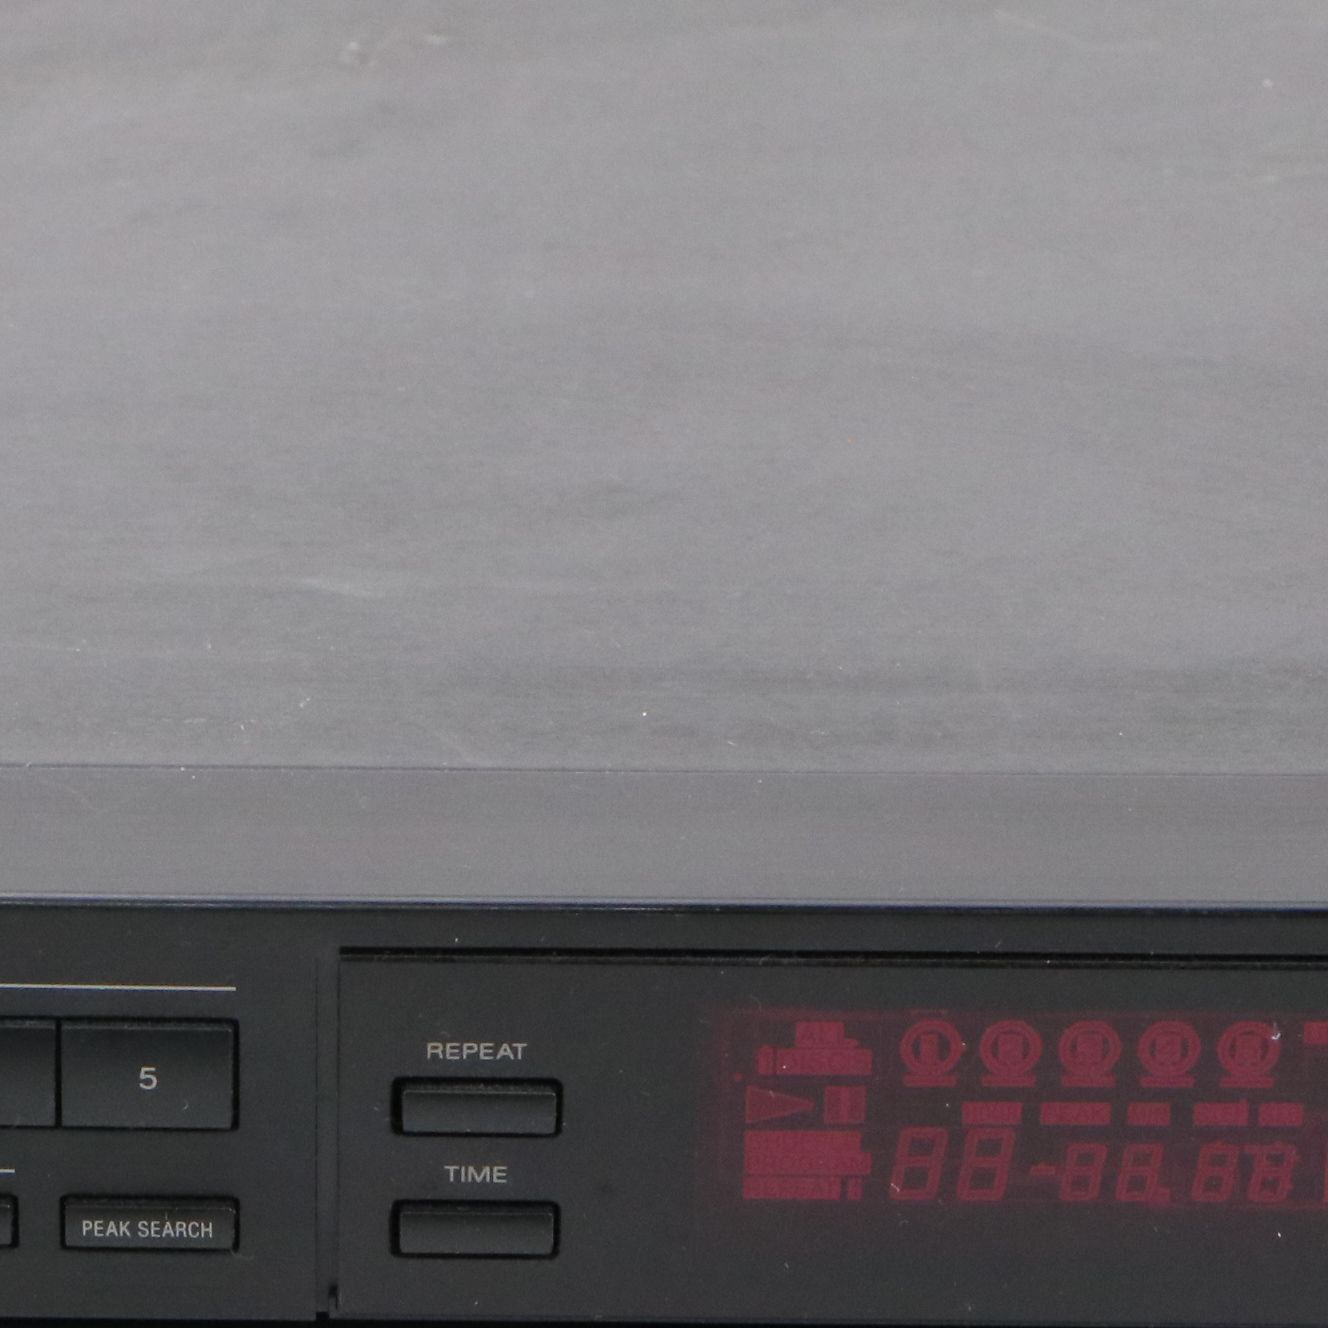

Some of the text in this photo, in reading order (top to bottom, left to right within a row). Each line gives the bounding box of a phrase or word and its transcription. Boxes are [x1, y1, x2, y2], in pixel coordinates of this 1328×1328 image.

[426, 1042, 528, 1060] REPEAT
[139, 1066, 158, 1090] 5
[443, 1165, 508, 1184] TIME
[82, 1220, 213, 1239] PEAK SEARCH
